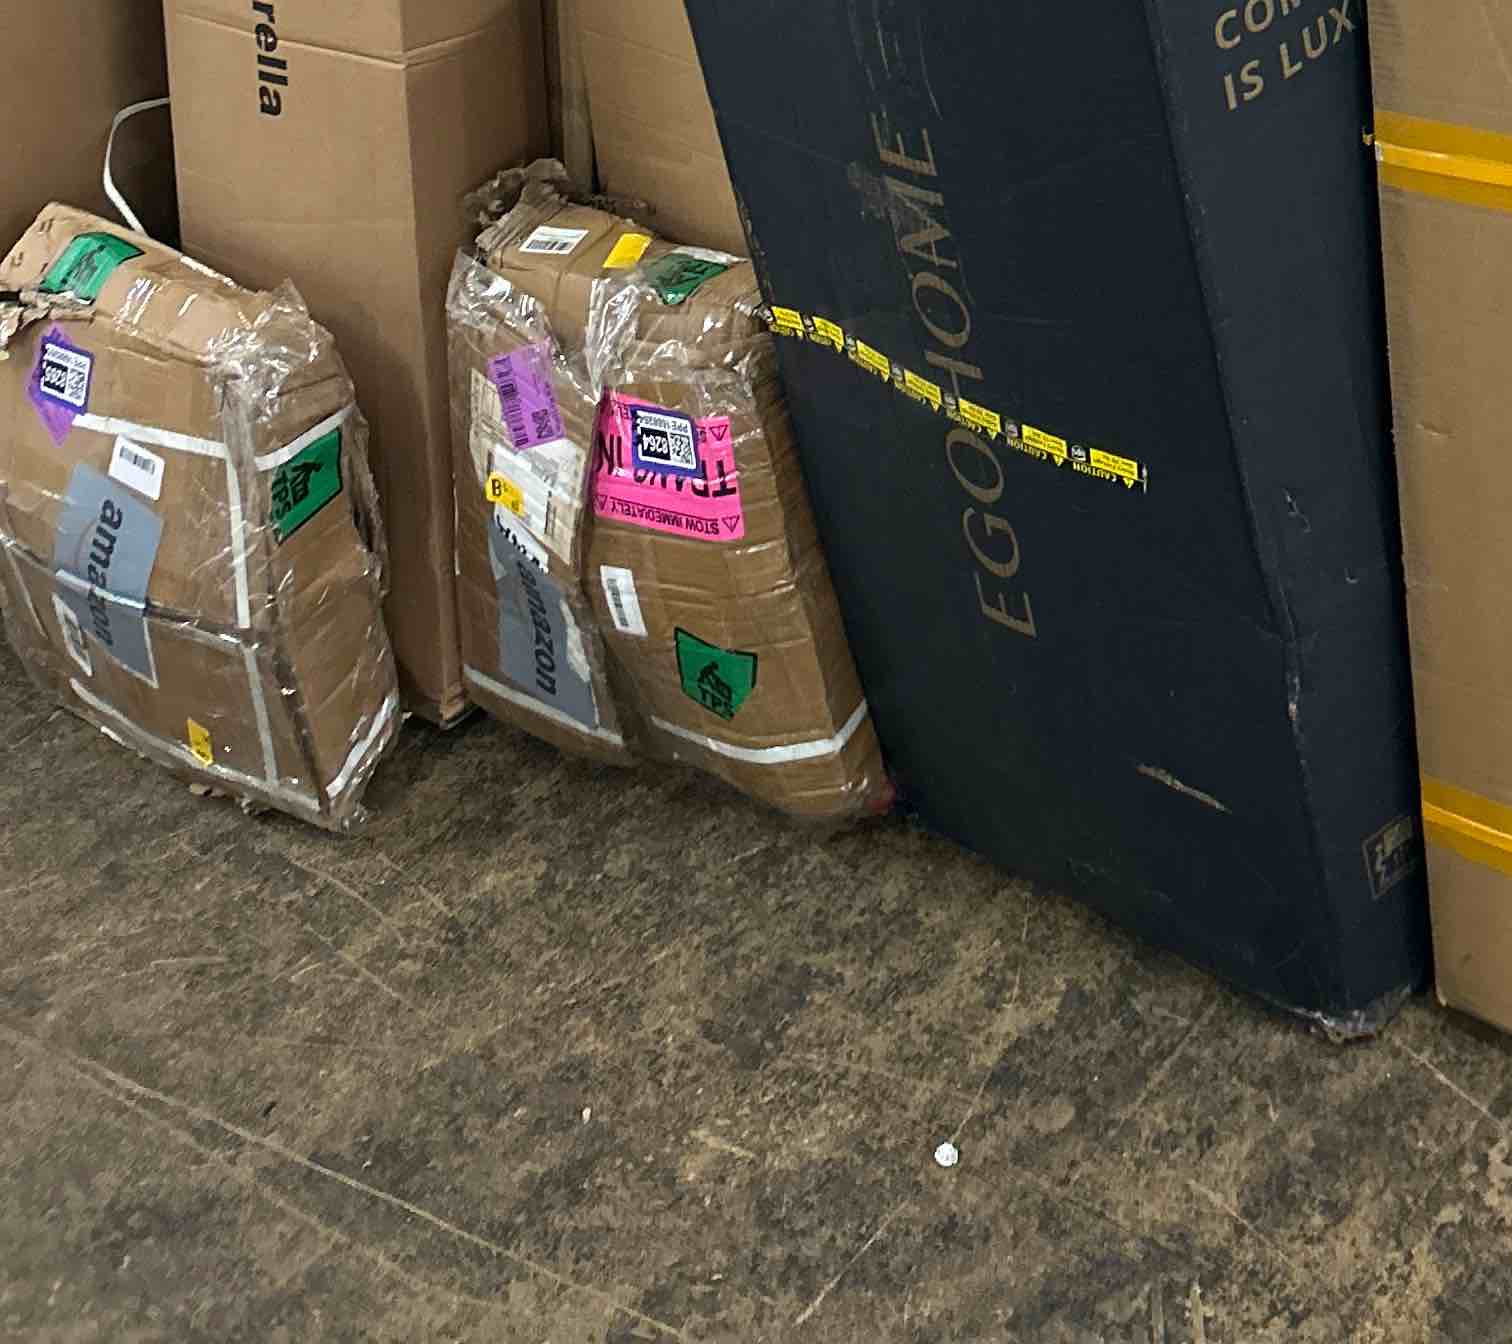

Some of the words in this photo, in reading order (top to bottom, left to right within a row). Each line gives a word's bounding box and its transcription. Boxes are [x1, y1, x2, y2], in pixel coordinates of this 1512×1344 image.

[1223, 58, 1265, 112] IS
[642, 433, 669, 454] 8264
[1071, 461, 1118, 483] CAUTION
[610, 499, 684, 527] IMMEDIATELY
[686, 517, 721, 535] STOW
[517, 558, 557, 696] amazon
